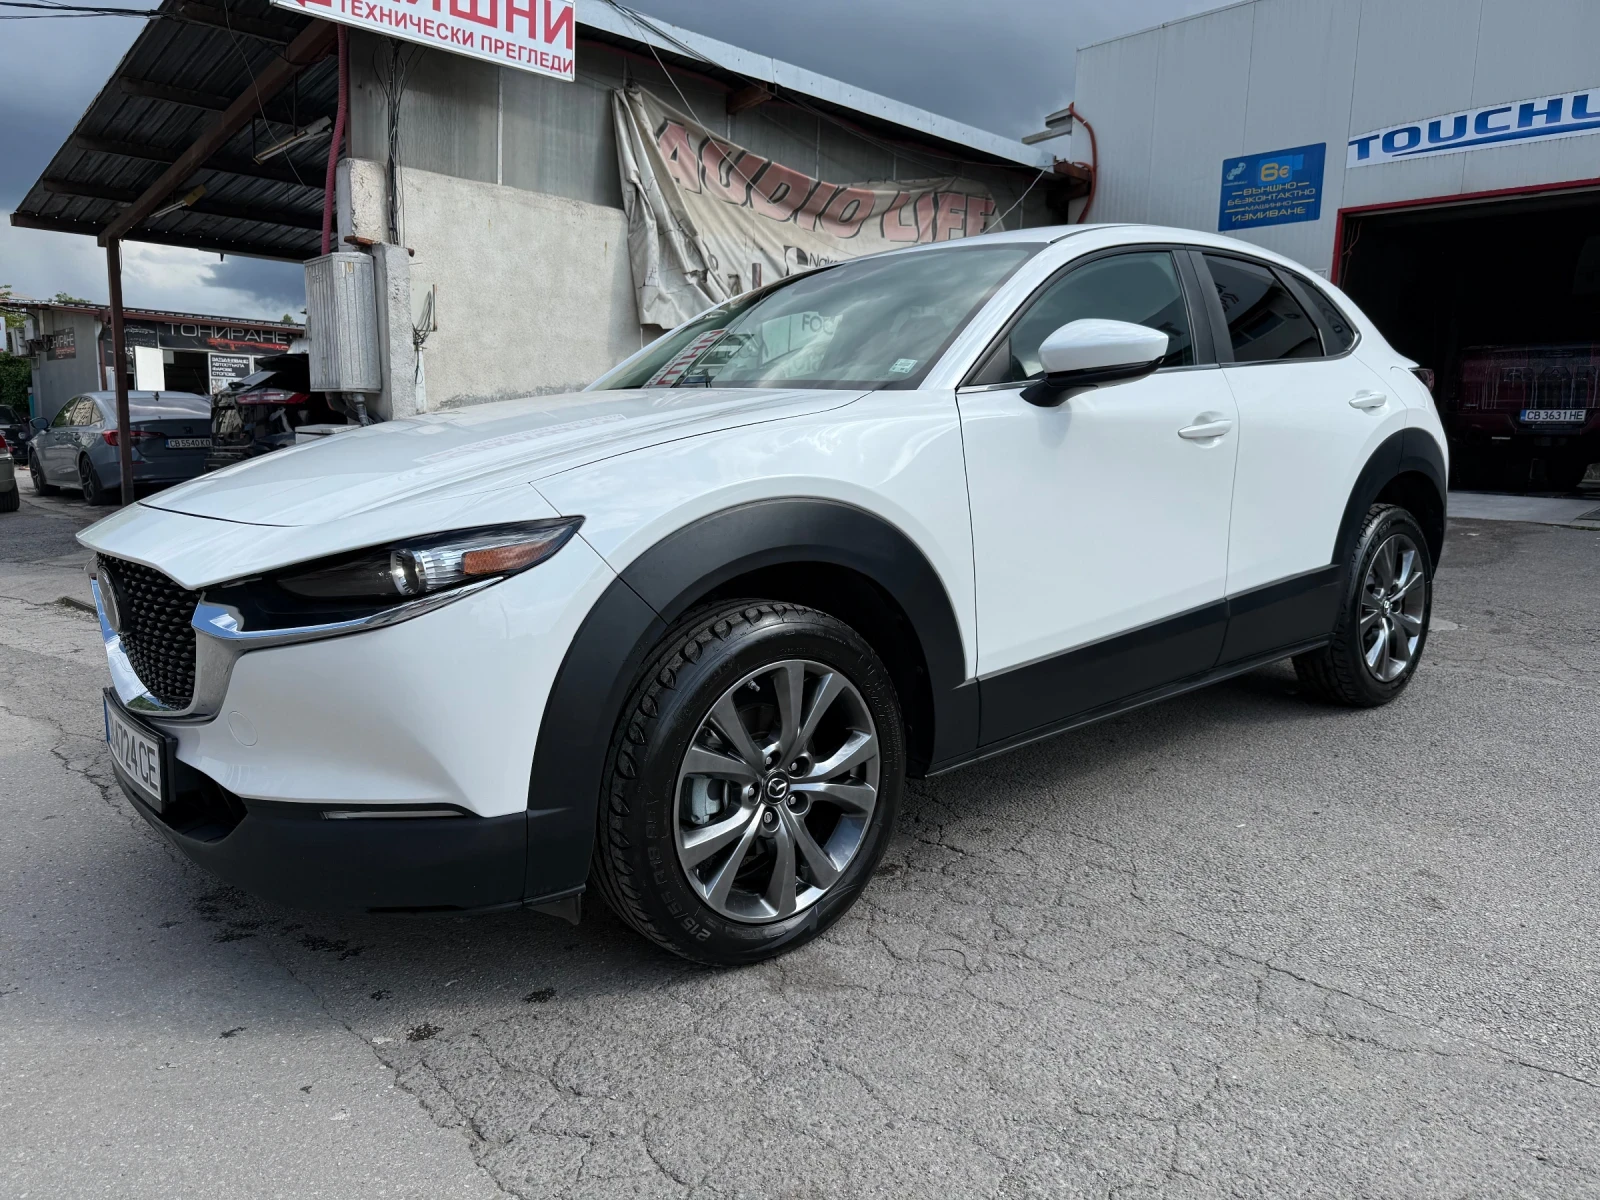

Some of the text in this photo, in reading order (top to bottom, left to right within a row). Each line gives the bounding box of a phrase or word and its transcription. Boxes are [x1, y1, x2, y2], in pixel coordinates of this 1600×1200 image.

[340, 0, 573, 74] ТЕХНИЧЕСКИ ПРЕГЛЕДИ
[656, 117, 996, 243] AUDIO LIFE
[1227, 188, 1316, 206] БЕЗКОНТАКТНО
[1243, 182, 1297, 196] ВЪНШНО
[1232, 206, 1306, 222] ИЗМИВАНЕ
[1245, 200, 1292, 211] МАШИННО
[165, 322, 287, 344] ТОНИРАНЕ
[1527, 411, 1584, 420] CB 3631 HE
